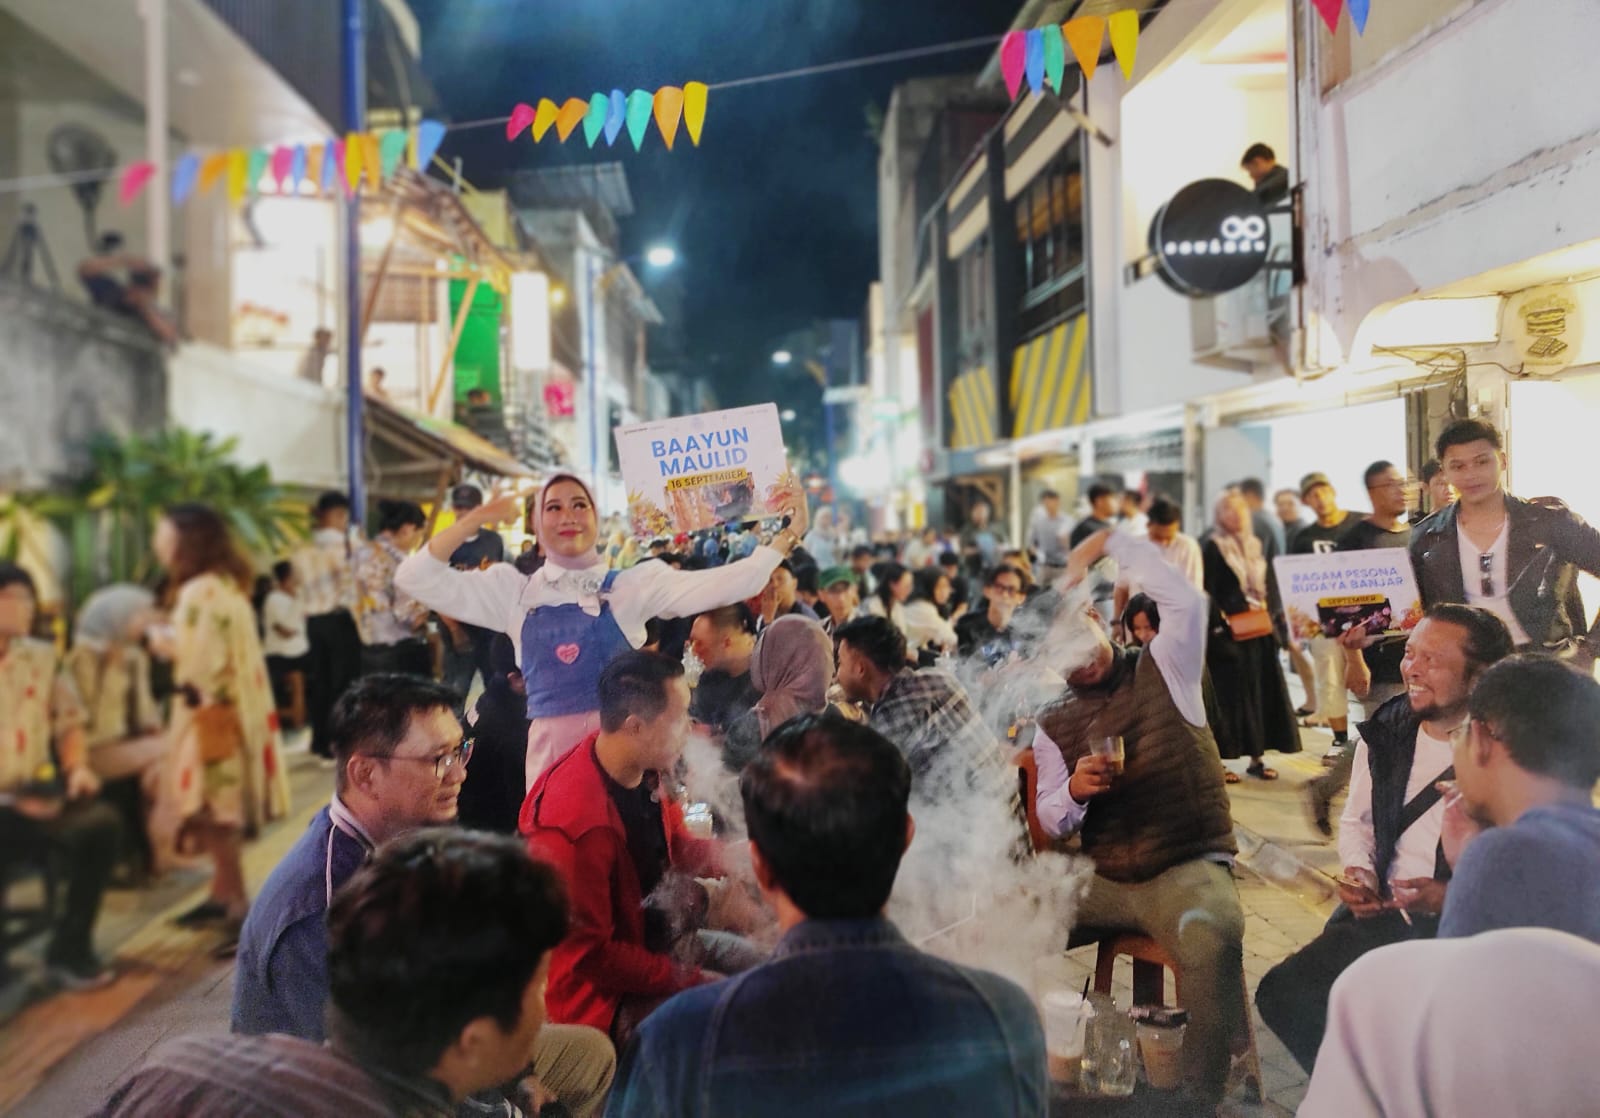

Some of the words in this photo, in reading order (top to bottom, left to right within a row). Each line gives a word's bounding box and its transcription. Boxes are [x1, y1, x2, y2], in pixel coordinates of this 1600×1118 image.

[651, 426, 749, 458] BAAYUN
[659, 447, 748, 477] MAULID
[671, 480, 682, 489] 16
[684, 470, 744, 487] SEPTEMBER
[1345, 567, 1398, 578] PESONA
[1291, 581, 1346, 593] BUDAYA
[1350, 576, 1404, 590] BANJAR
